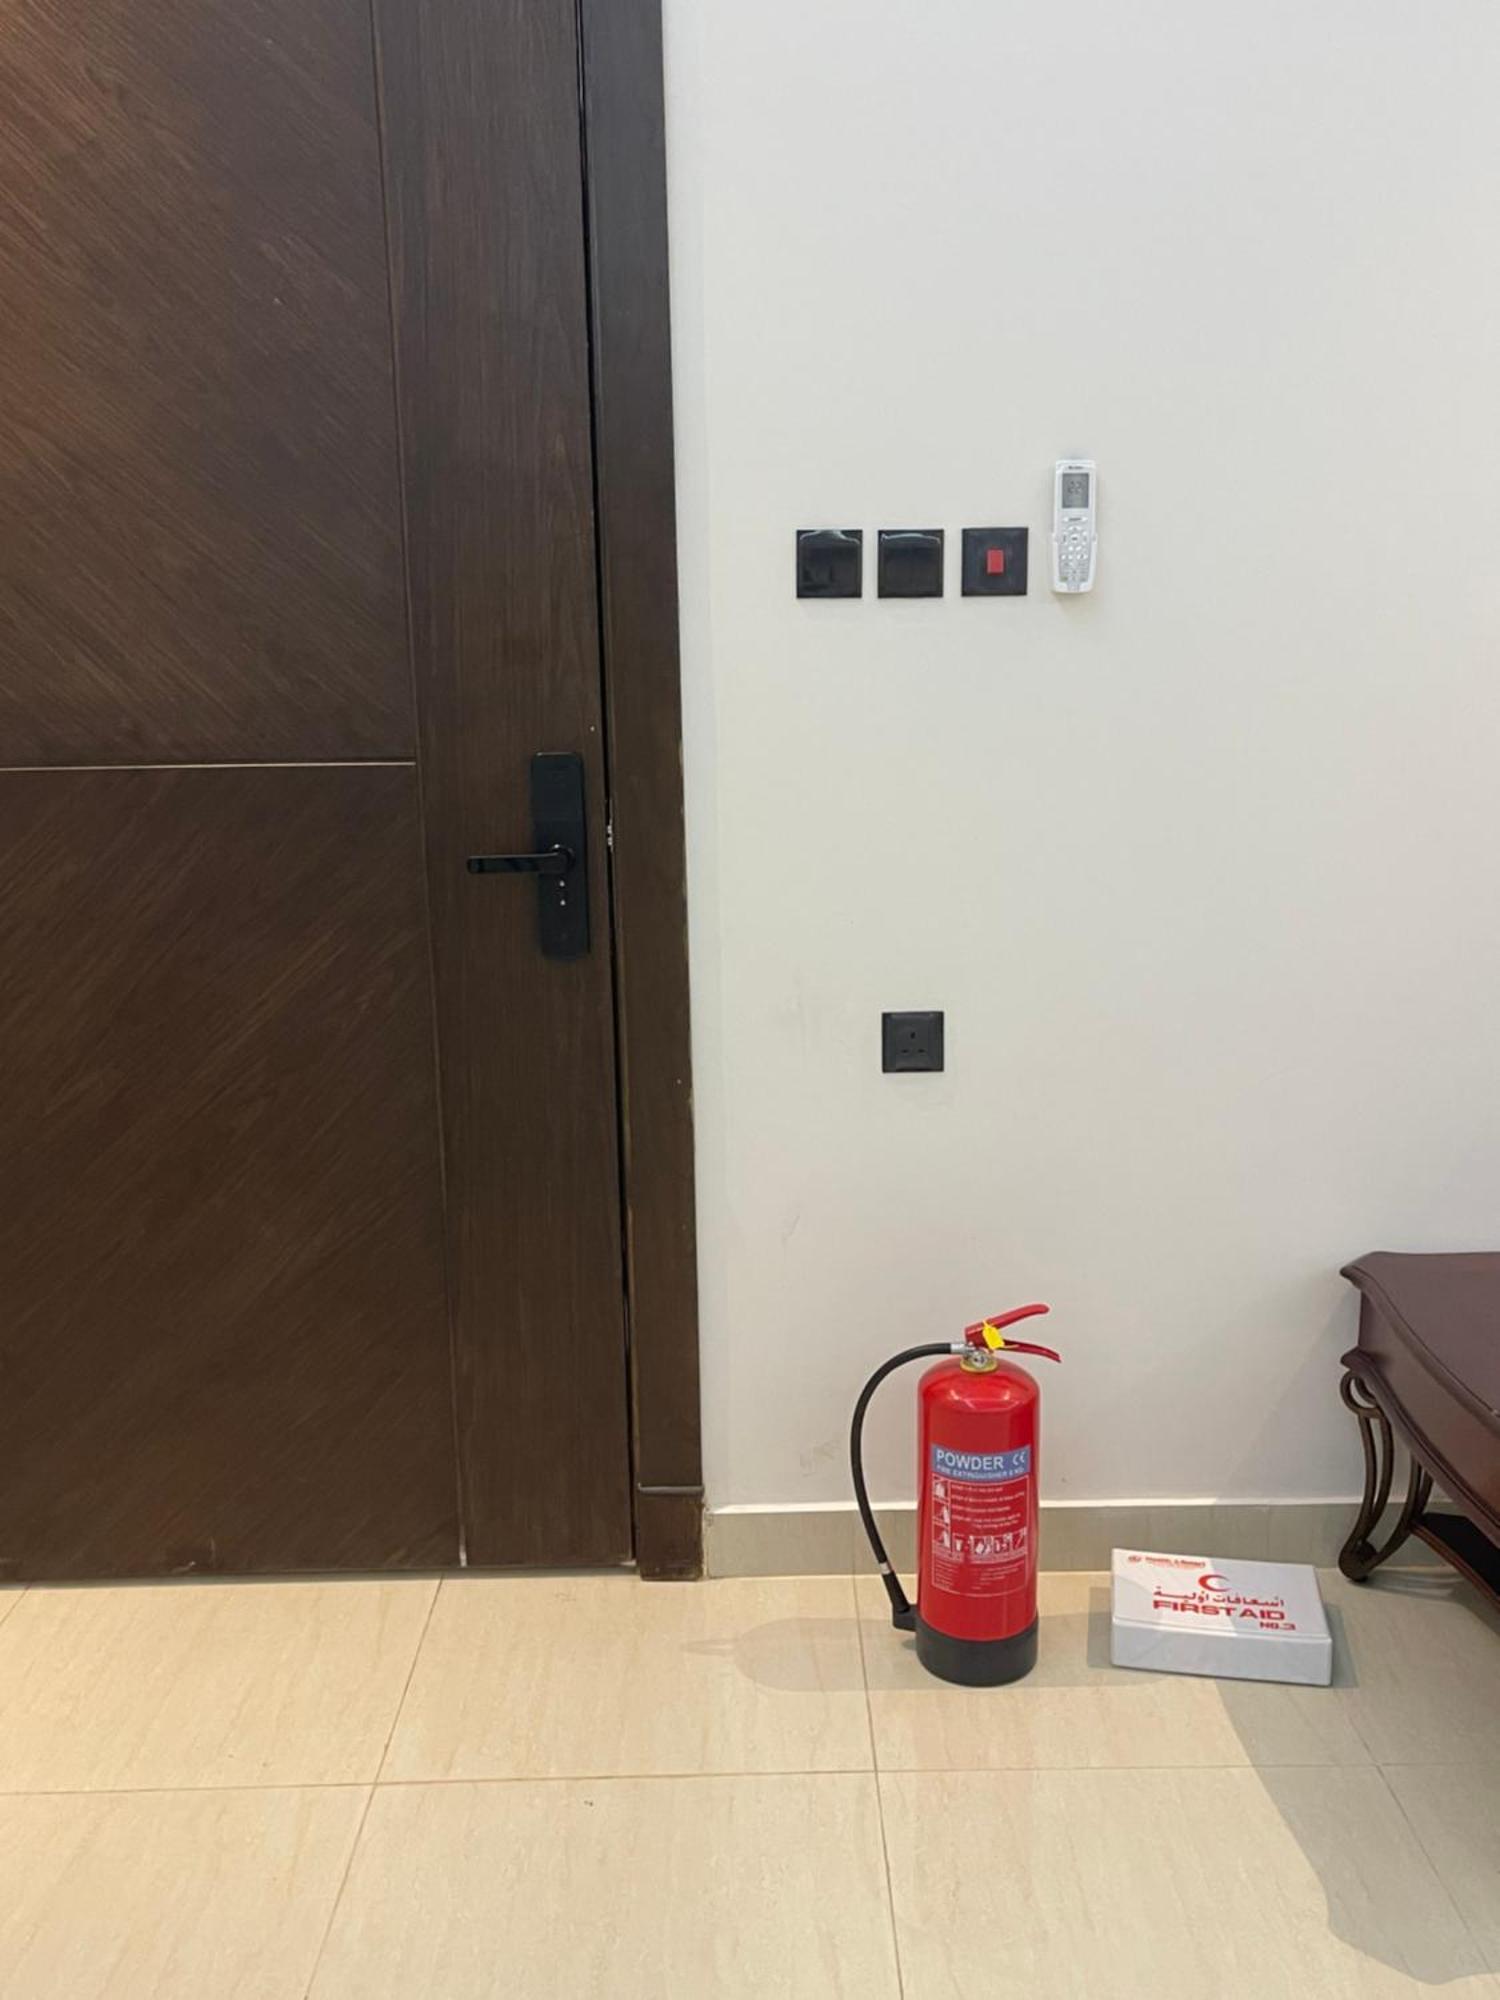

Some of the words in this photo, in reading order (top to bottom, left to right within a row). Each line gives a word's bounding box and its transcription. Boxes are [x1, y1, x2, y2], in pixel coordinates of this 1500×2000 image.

[936, 1449, 1004, 1470] POWDER
[1152, 1599, 1238, 1616] FIRST
[1239, 1608, 1285, 1620] AID
